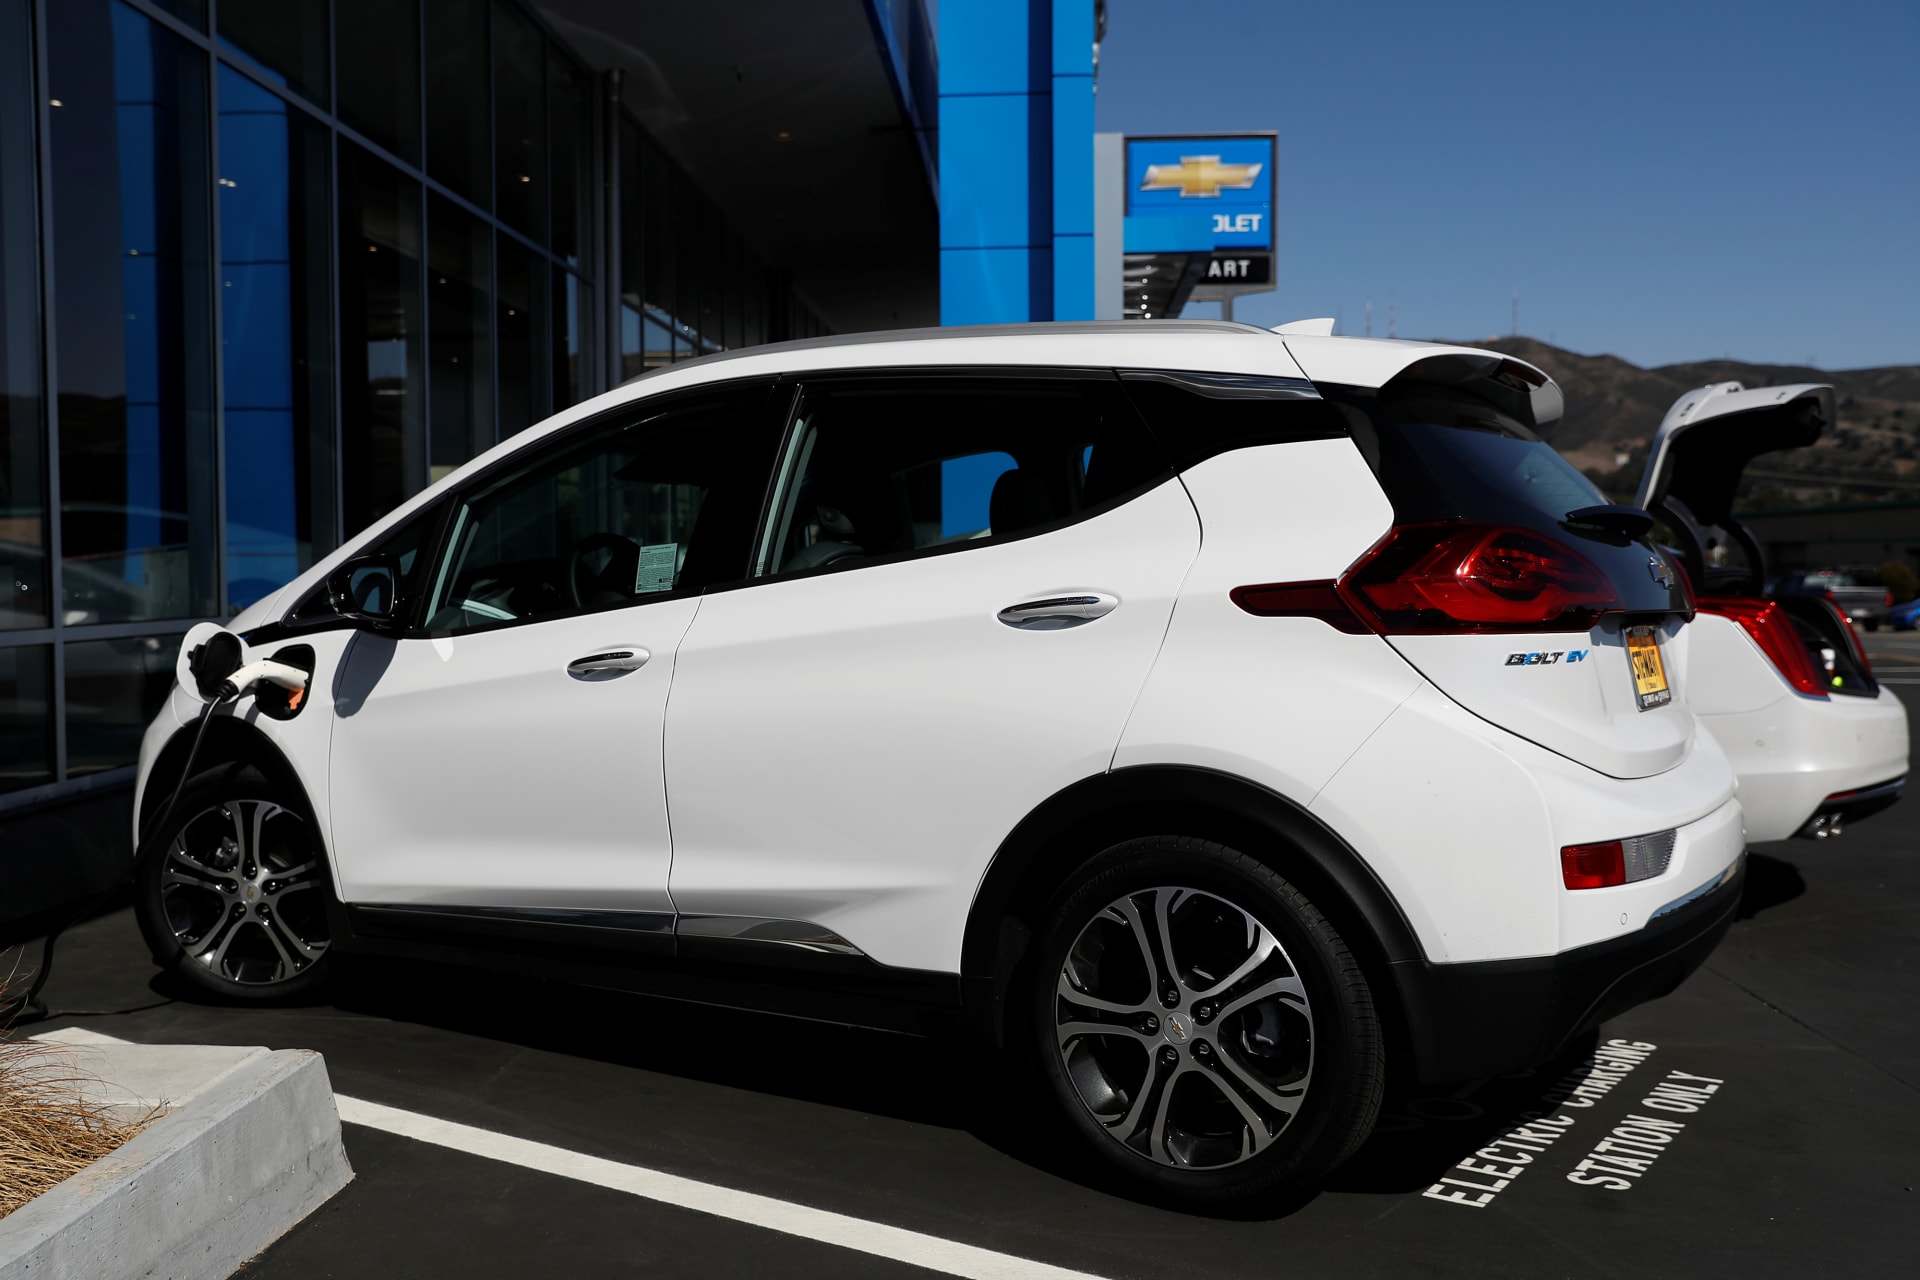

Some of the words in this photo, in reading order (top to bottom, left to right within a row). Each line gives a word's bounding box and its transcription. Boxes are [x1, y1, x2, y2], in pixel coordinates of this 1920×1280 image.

[1207, 259, 1251, 278] ART
[1504, 652, 1564, 666] BOLT
[1566, 649, 1589, 663] EV
[1421, 1111, 1575, 1208] ELECTRIC
[1542, 1038, 1658, 1108] CHARGING
[1566, 1113, 1686, 1190] STATION
[1641, 1069, 1724, 1113] ONLY
